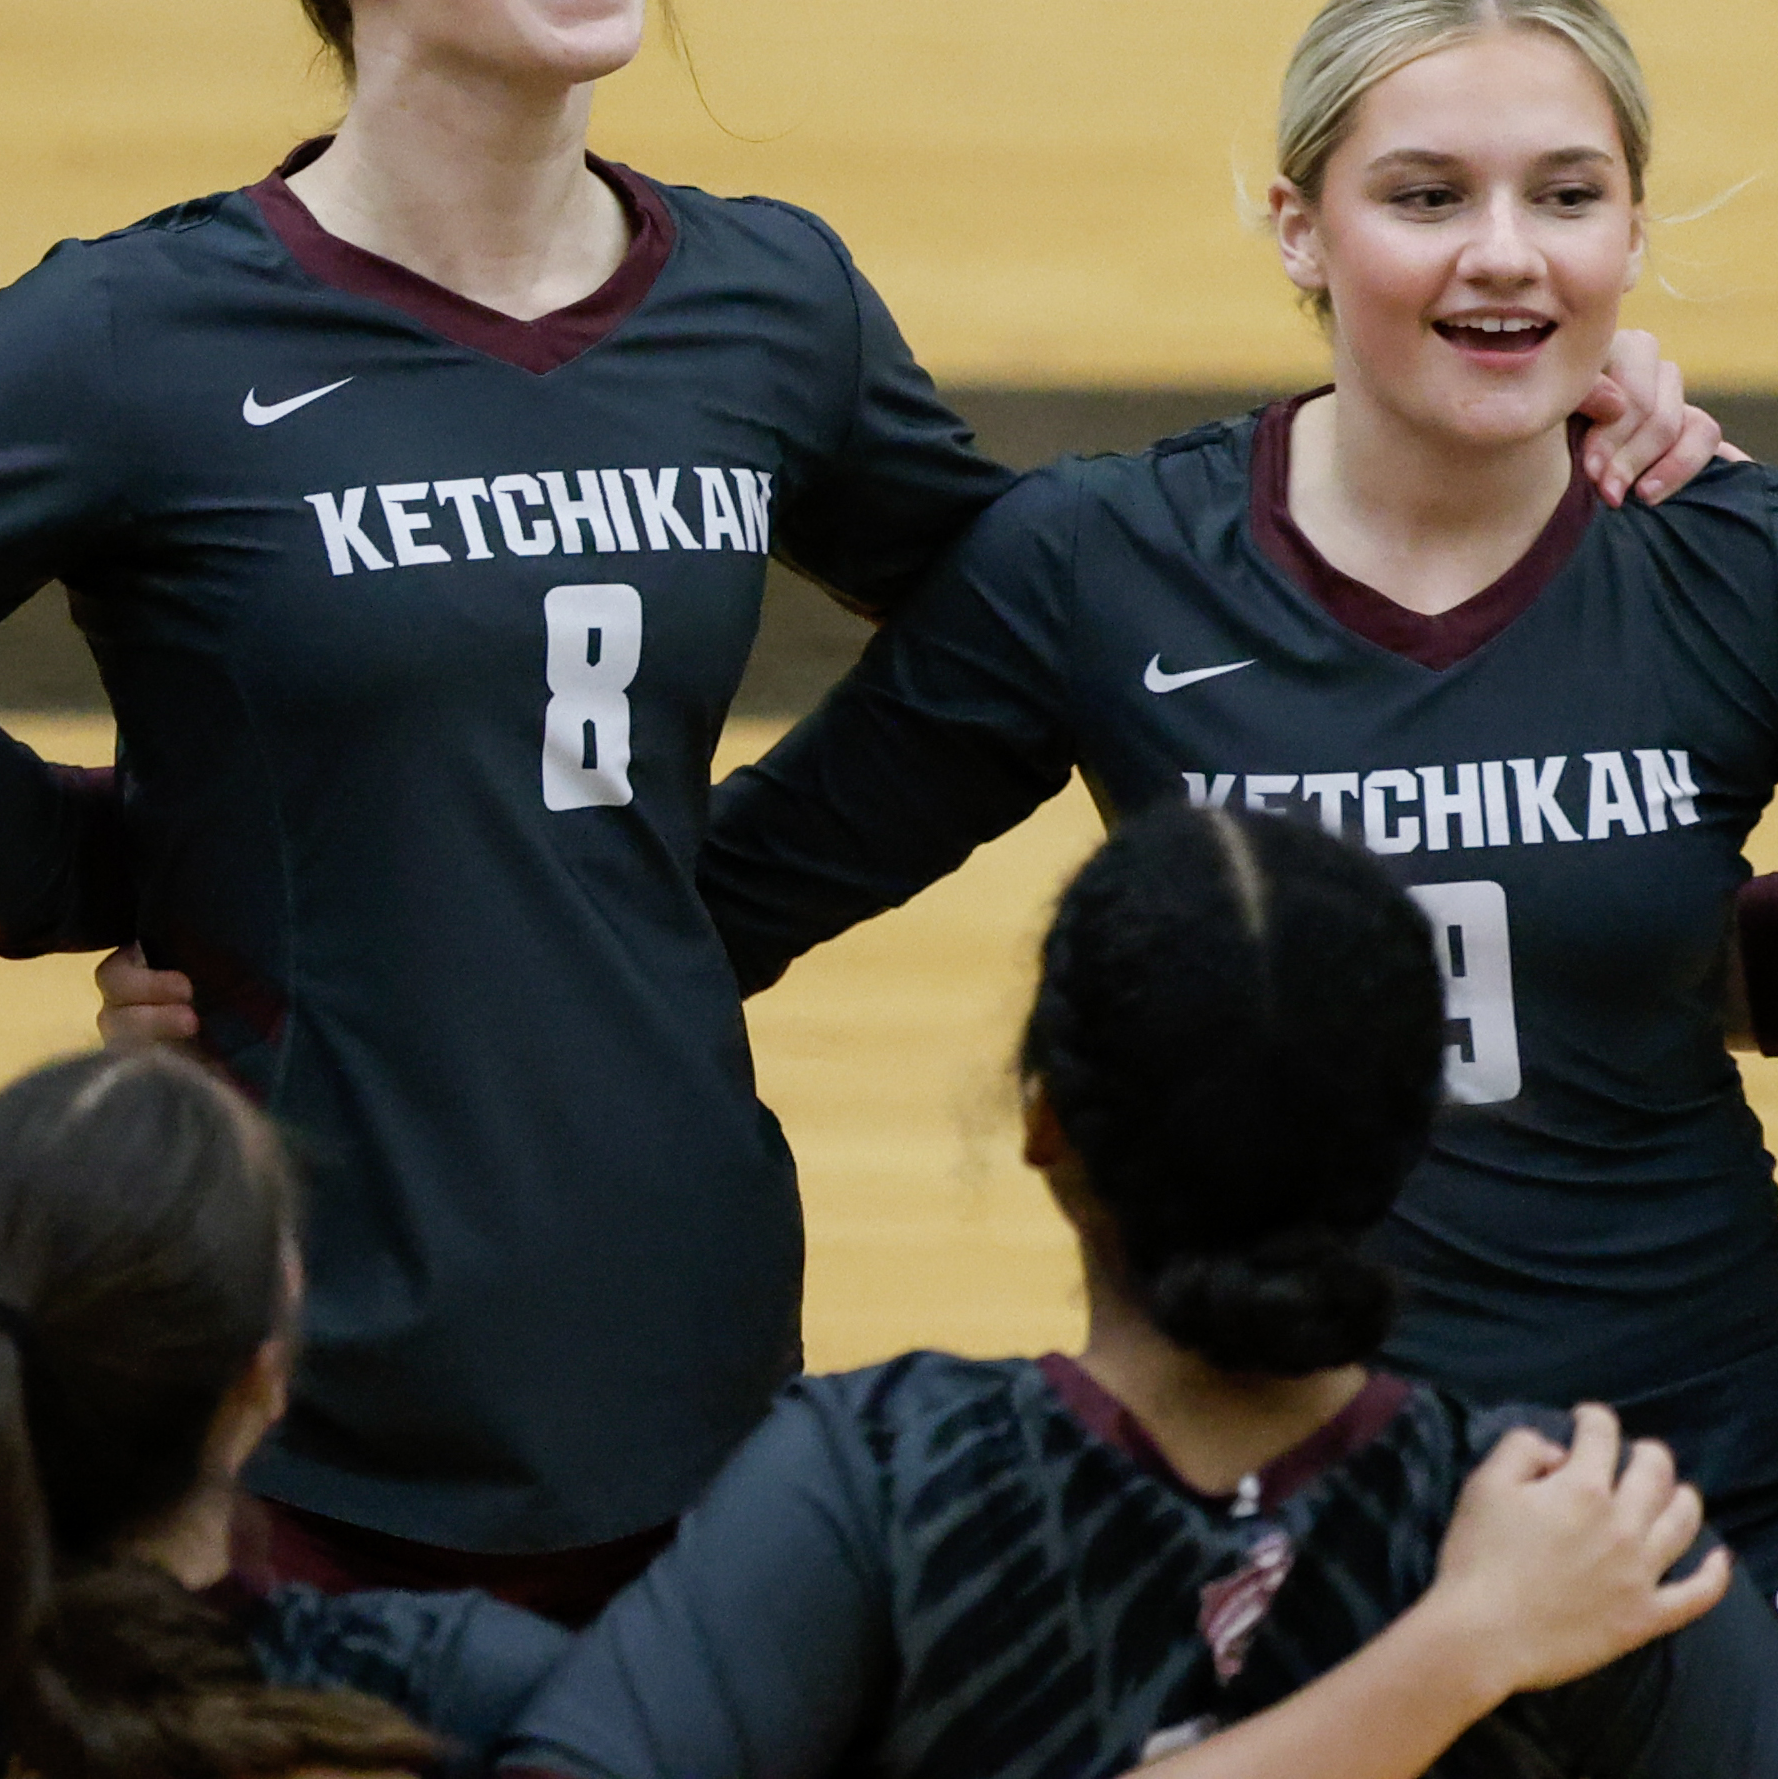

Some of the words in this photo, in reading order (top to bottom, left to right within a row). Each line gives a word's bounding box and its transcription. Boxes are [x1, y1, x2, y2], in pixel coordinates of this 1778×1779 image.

[304, 467, 773, 576] KETCHIKAN
[543, 583, 642, 812] 8
[1406, 880, 1522, 1105] 9
